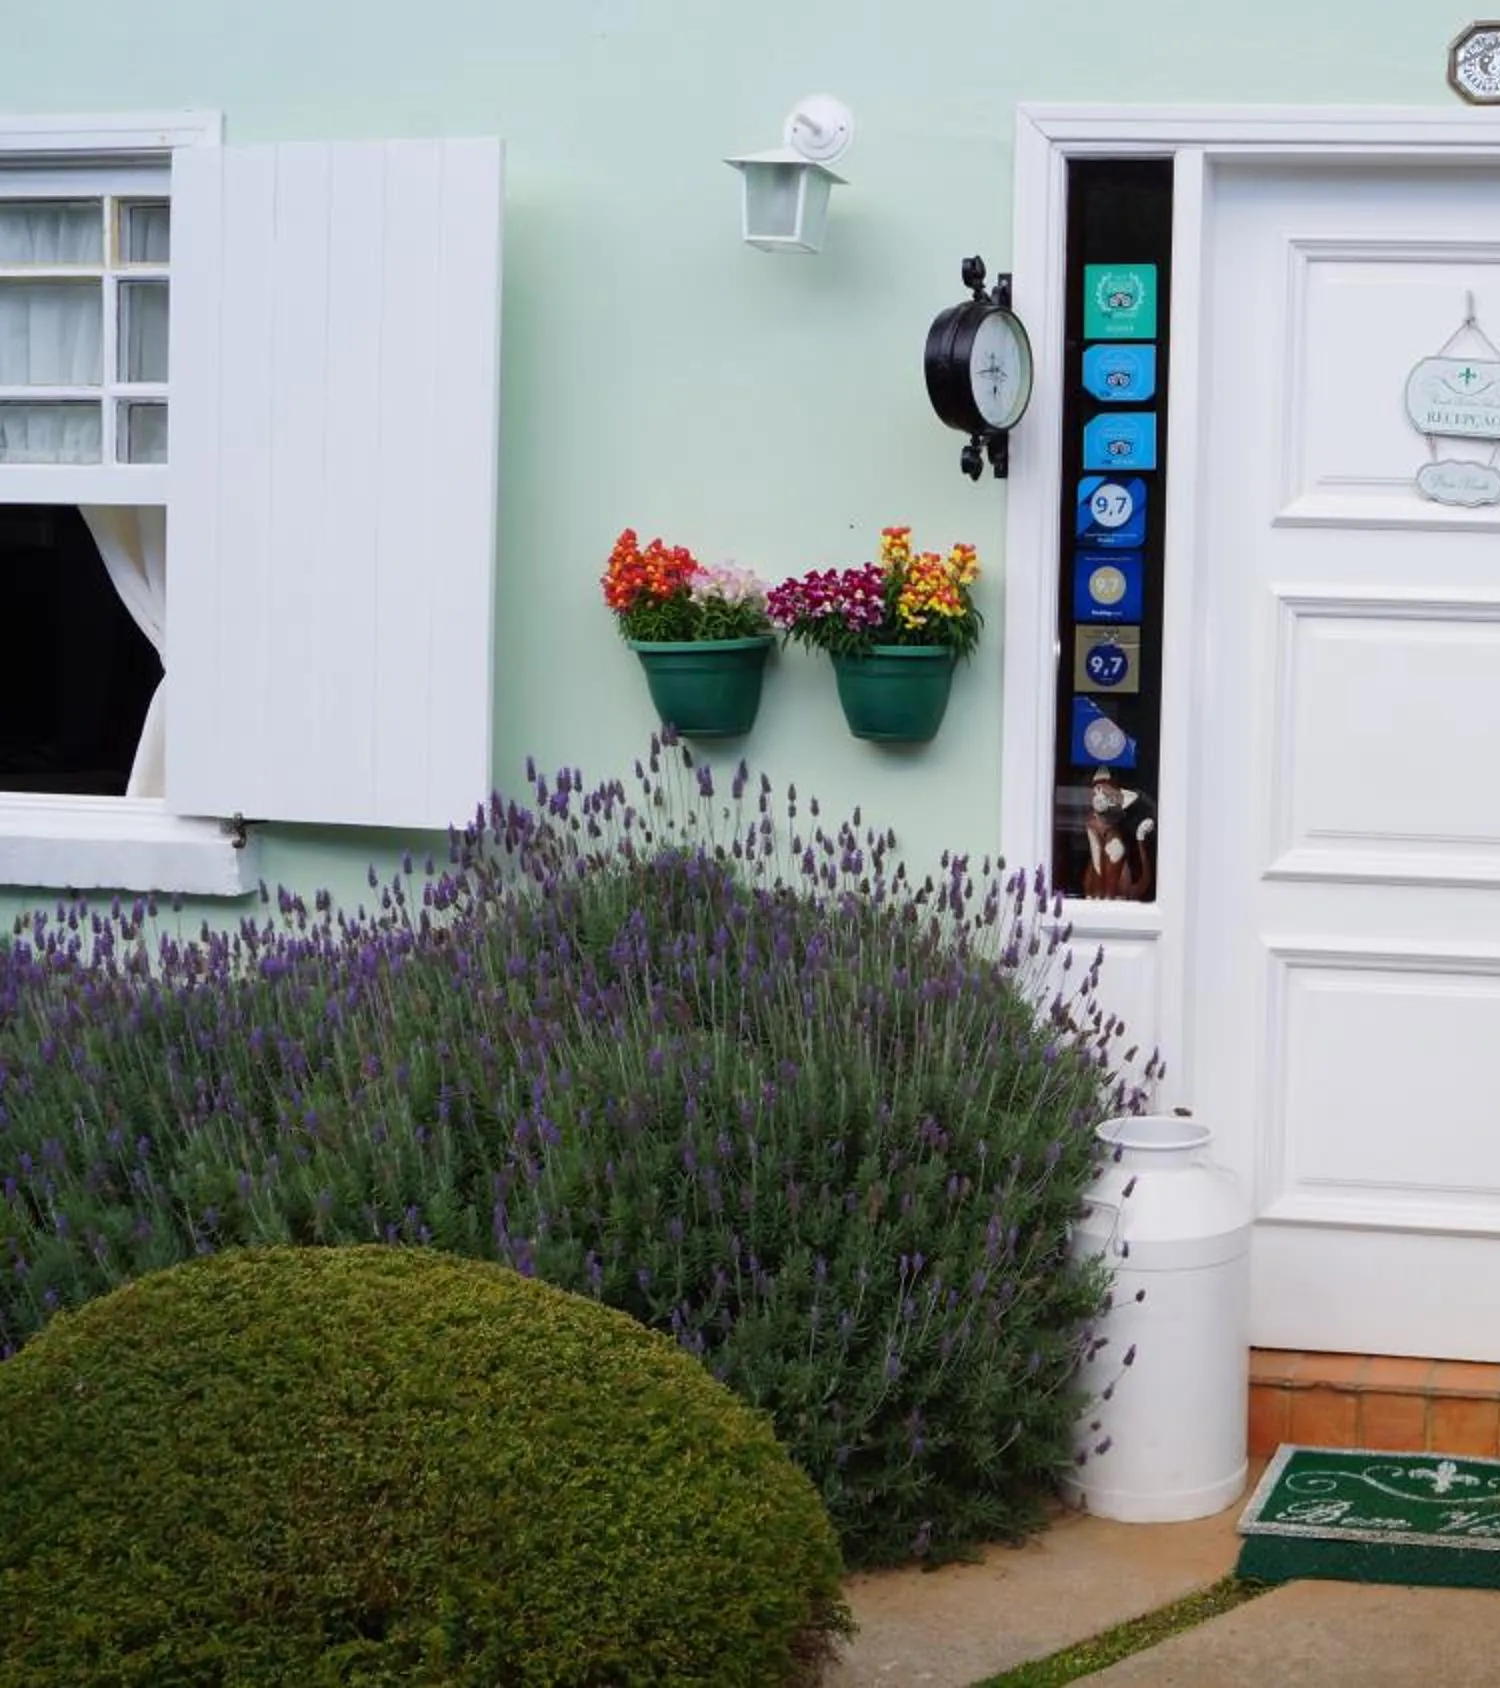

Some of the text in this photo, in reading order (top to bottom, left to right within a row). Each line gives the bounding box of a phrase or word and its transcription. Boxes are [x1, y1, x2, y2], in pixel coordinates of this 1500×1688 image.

[1095, 496, 1128, 517] 9,7
[1090, 656, 1122, 676] 9,7
[1276, 1499, 1413, 1528] Bem
